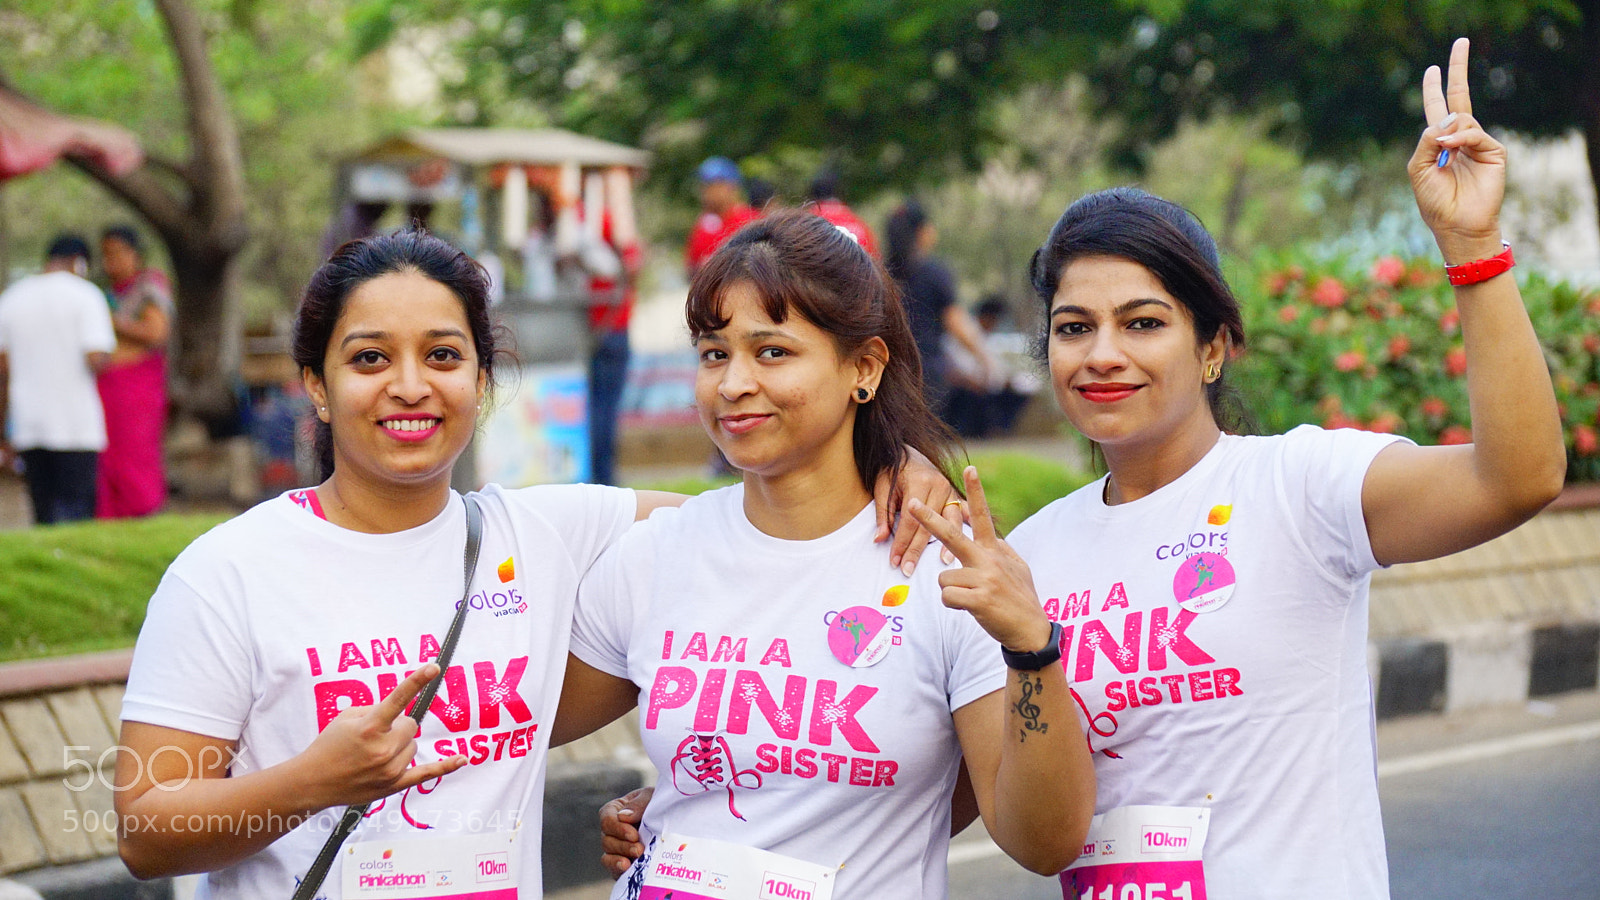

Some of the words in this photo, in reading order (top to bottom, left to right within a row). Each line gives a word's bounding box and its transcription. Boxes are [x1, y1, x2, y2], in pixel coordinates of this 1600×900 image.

[1043, 590, 1091, 622] AM
[1101, 582, 1129, 611] A
[306, 647, 322, 676] I
[337, 637, 408, 673] AM
[419, 633, 441, 663] A
[661, 630, 674, 660] I
[680, 632, 748, 662] AM
[760, 638, 792, 668] A
[1061, 607, 1216, 682] INK
[1104, 667, 1244, 712] SISTER
[645, 666, 881, 753] PINK
[755, 742, 899, 787] SISTER
[1144, 831, 1188, 848] 10km
[359, 860, 394, 870] colors
[478, 859, 507, 876] 10km
[661, 850, 684, 861] colors
[359, 874, 426, 888] Pinkathon
[655, 863, 702, 881] Pinkathon
[765, 879, 812, 900] 10km
